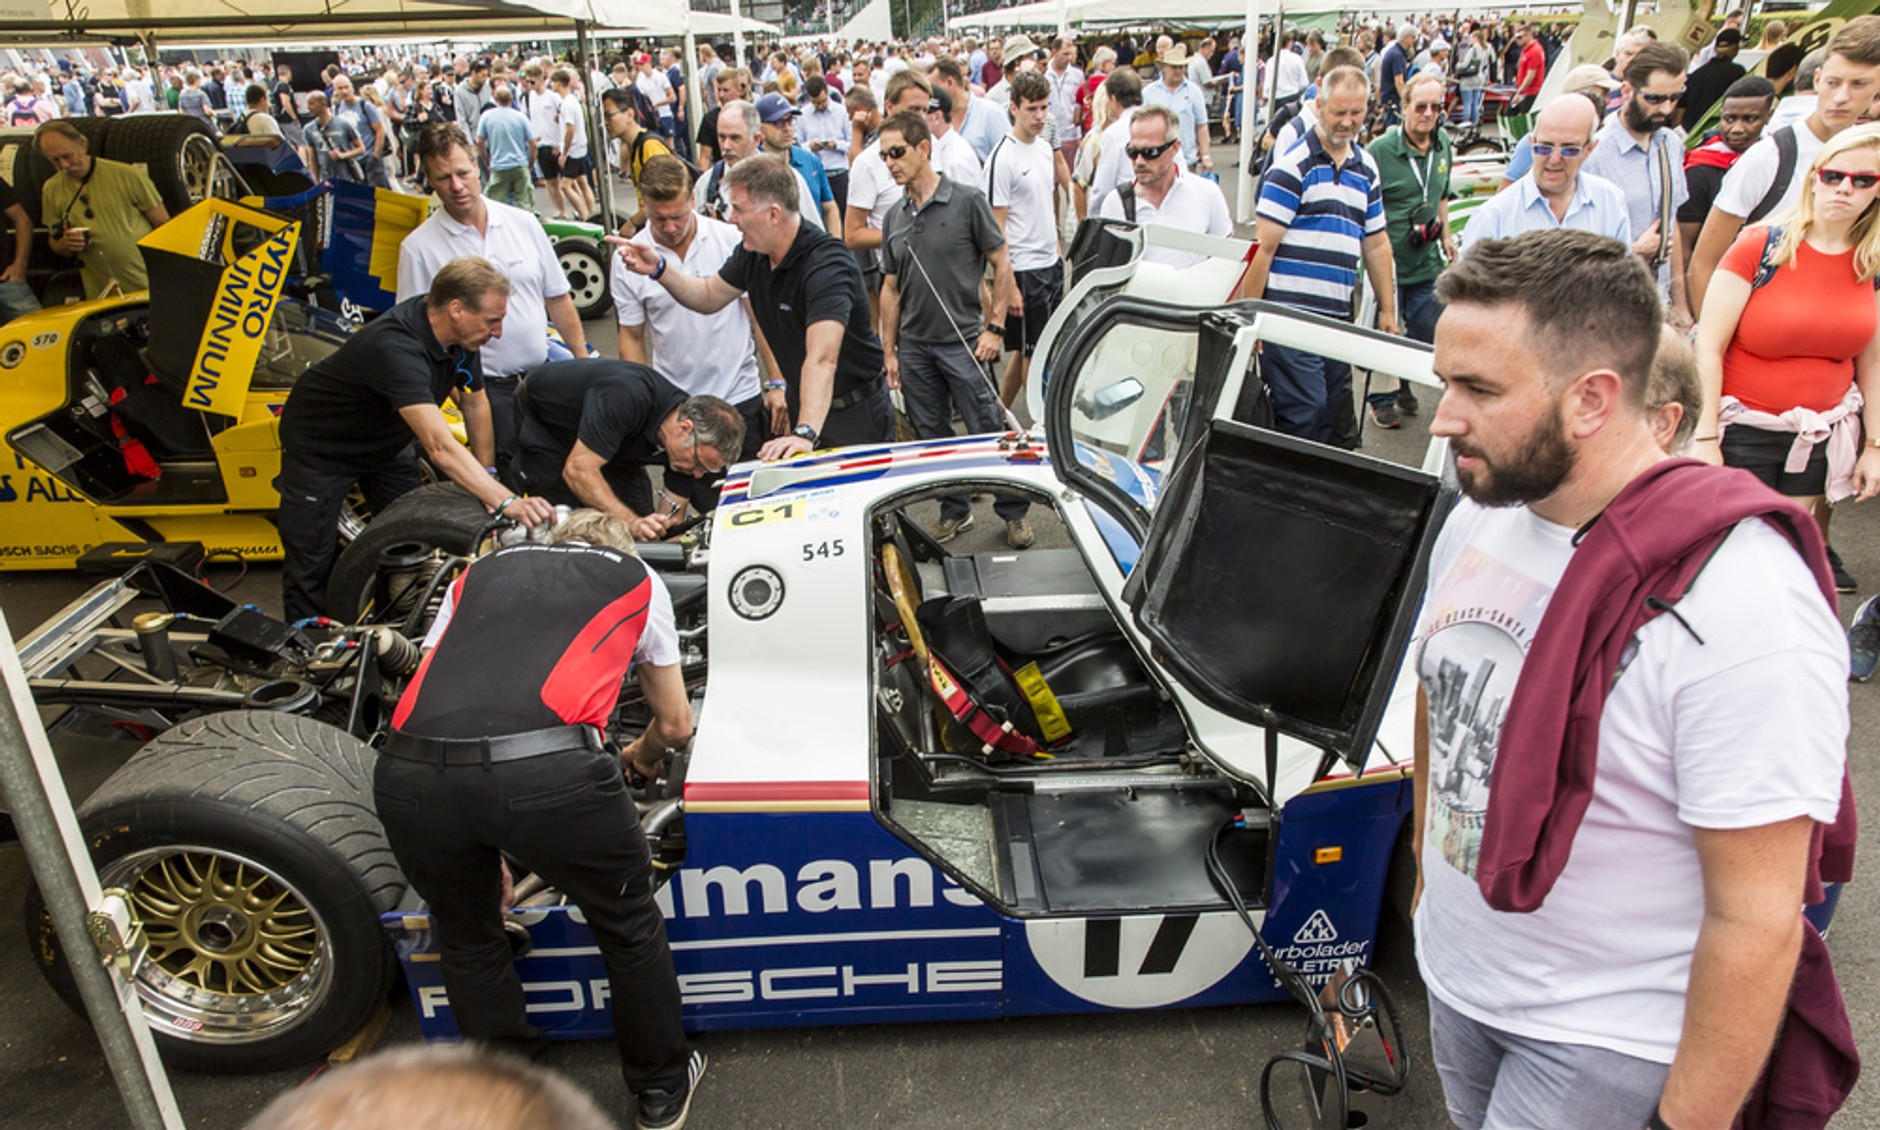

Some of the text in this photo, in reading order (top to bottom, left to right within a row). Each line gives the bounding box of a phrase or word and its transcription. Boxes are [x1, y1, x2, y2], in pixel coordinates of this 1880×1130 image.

[243, 225, 296, 339] HYDRO
[731, 503, 793, 526] C1
[802, 538, 845, 562] 545
